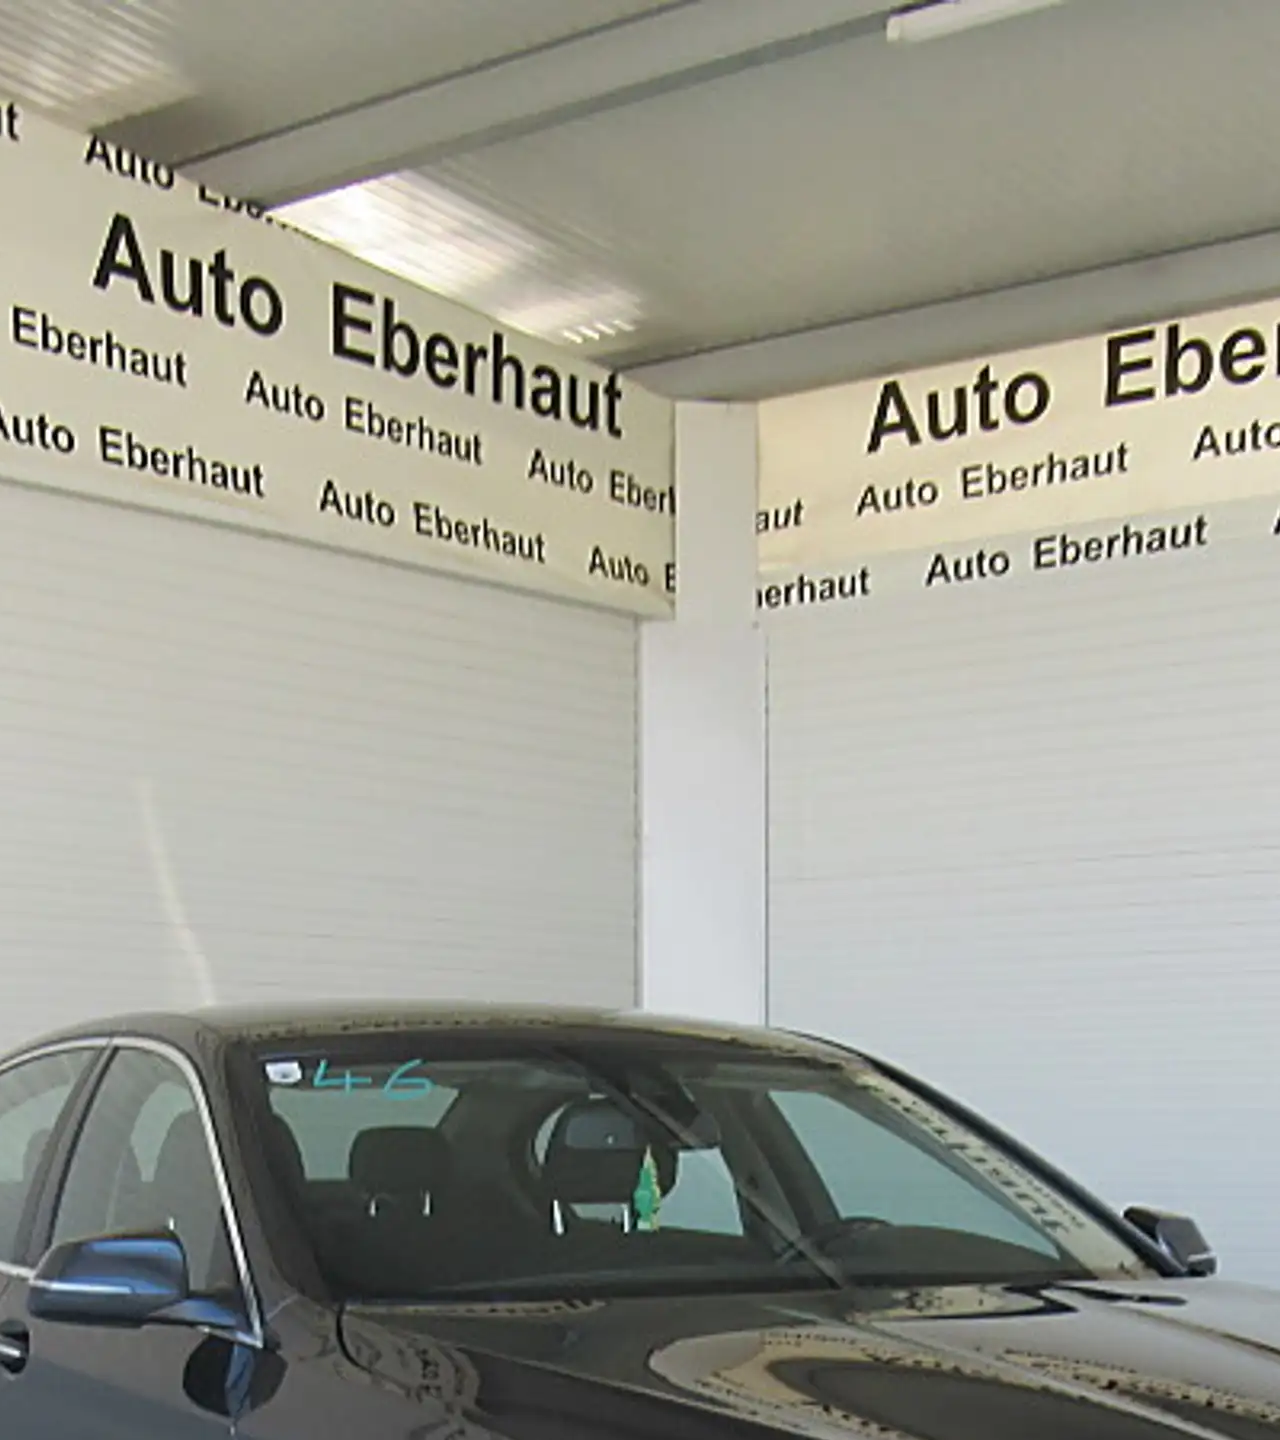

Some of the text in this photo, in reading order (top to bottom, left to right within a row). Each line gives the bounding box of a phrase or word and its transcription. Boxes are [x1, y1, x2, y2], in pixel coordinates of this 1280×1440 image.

[13, 307, 186, 386] Eberhaut
[90, 213, 625, 441] Auto Eberhaut
[247, 371, 481, 464] Auto Eberhaut
[867, 367, 1049, 453] Auto
[100, 427, 263, 497] Eberhaut
[529, 449, 592, 492] Auto
[858, 443, 1126, 516] Auto Eberhaut
[320, 480, 544, 563] Auto Eberhaut
[927, 516, 1205, 585] Auto Eberhaut
[589, 546, 649, 586] Auto
